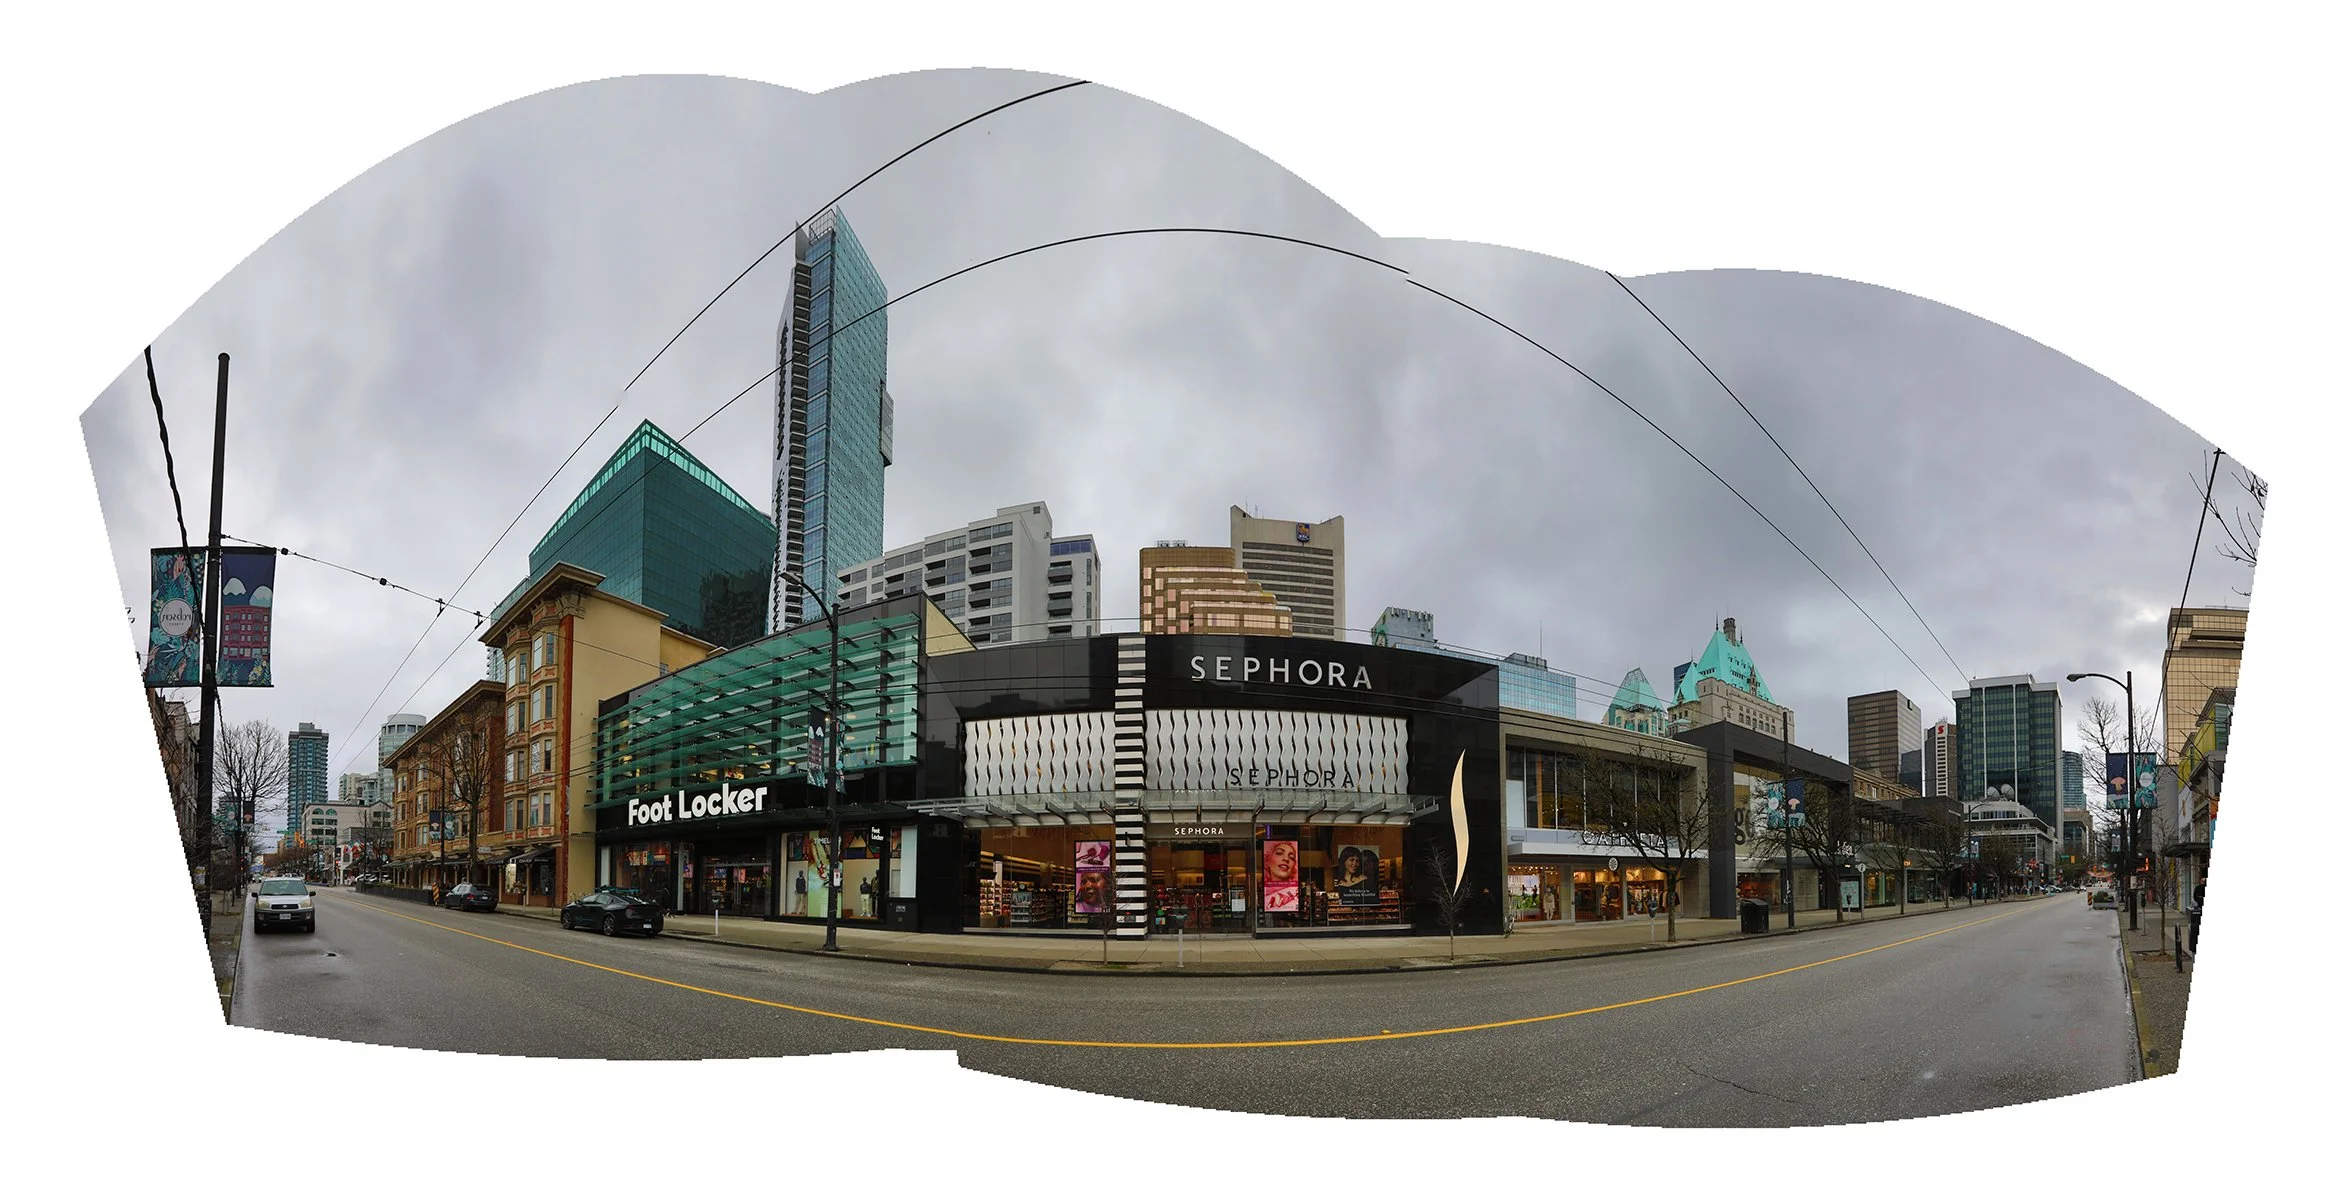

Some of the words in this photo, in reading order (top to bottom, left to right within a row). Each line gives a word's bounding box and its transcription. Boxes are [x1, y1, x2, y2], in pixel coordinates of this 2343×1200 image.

[1190, 655, 1372, 690] SEPHORA
[1230, 768, 1355, 789] SEPHORA
[628, 794, 673, 826] Foot
[678, 782, 768, 819] Locker
[1174, 827, 1225, 836] SEPHORA
